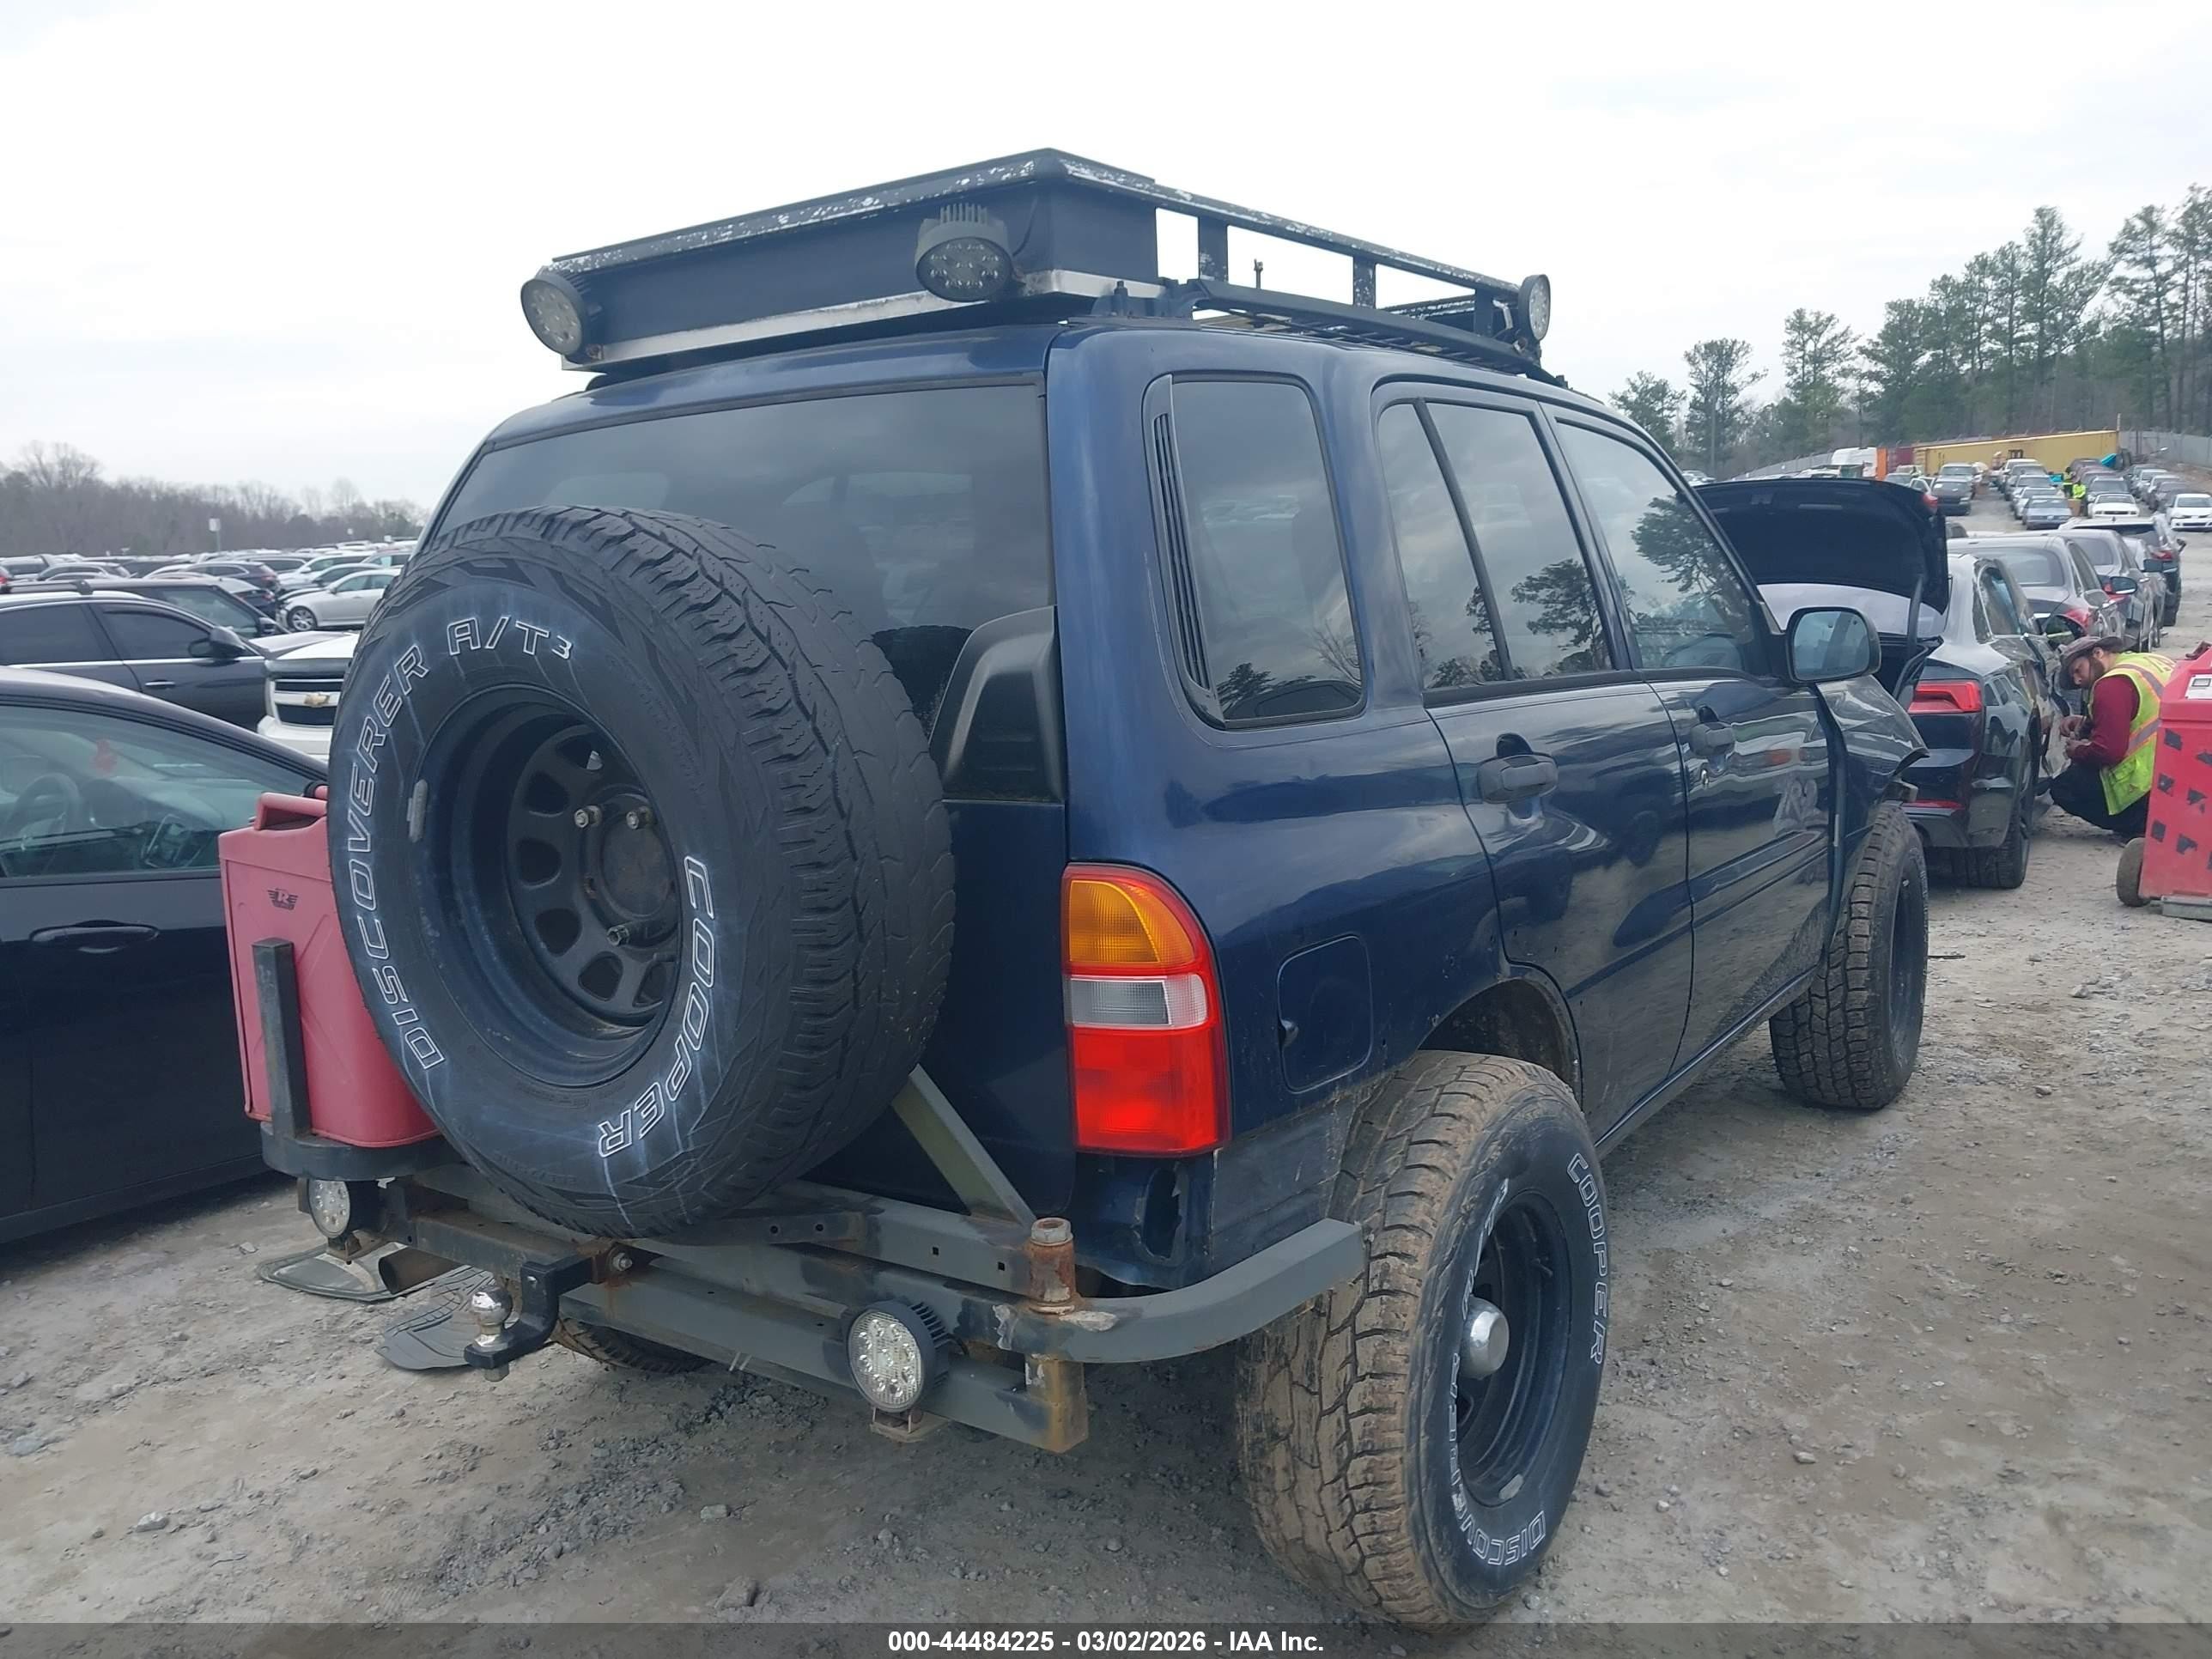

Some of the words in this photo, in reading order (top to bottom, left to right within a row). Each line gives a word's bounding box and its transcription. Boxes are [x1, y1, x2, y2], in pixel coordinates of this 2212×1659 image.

[346, 643, 446, 1070] DISCOVERER
[598, 855, 716, 1158] COOPER
[1566, 1152, 1610, 1365] COOPER
